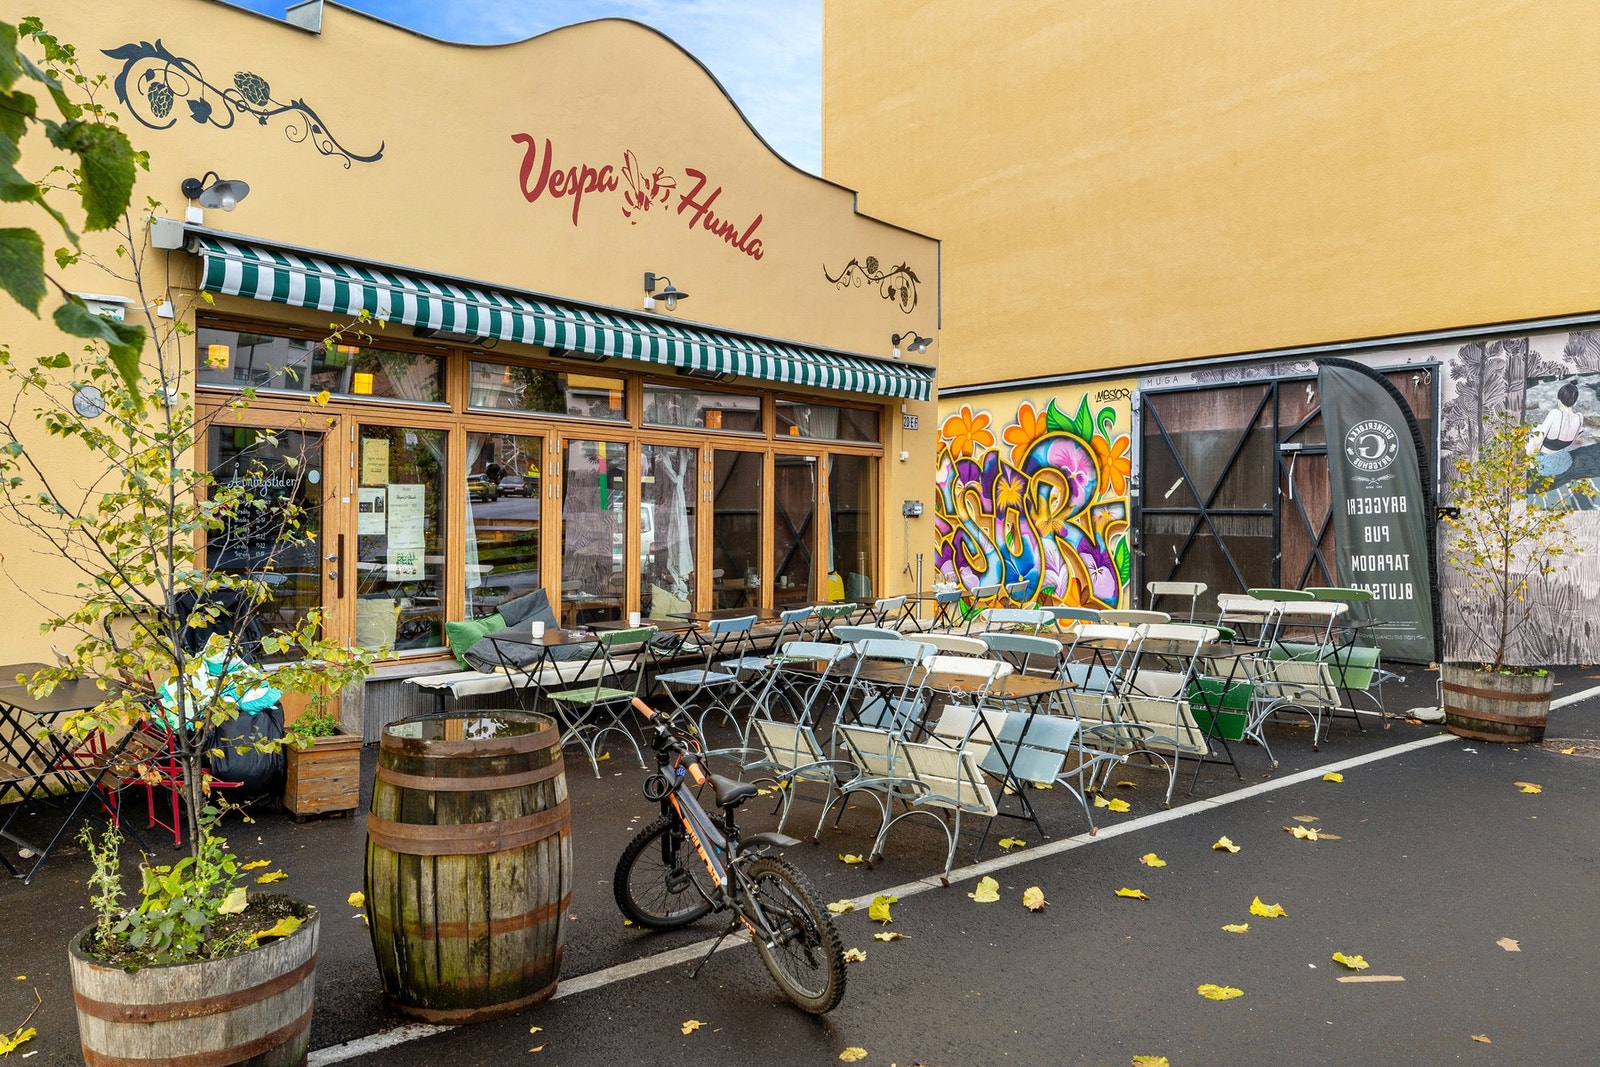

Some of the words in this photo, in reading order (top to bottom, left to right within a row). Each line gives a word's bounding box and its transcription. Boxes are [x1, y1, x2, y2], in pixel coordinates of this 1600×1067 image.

[511, 133, 619, 227] Vespa
[677, 168, 764, 261] Humla
[1147, 376, 1179, 386] MUGA
